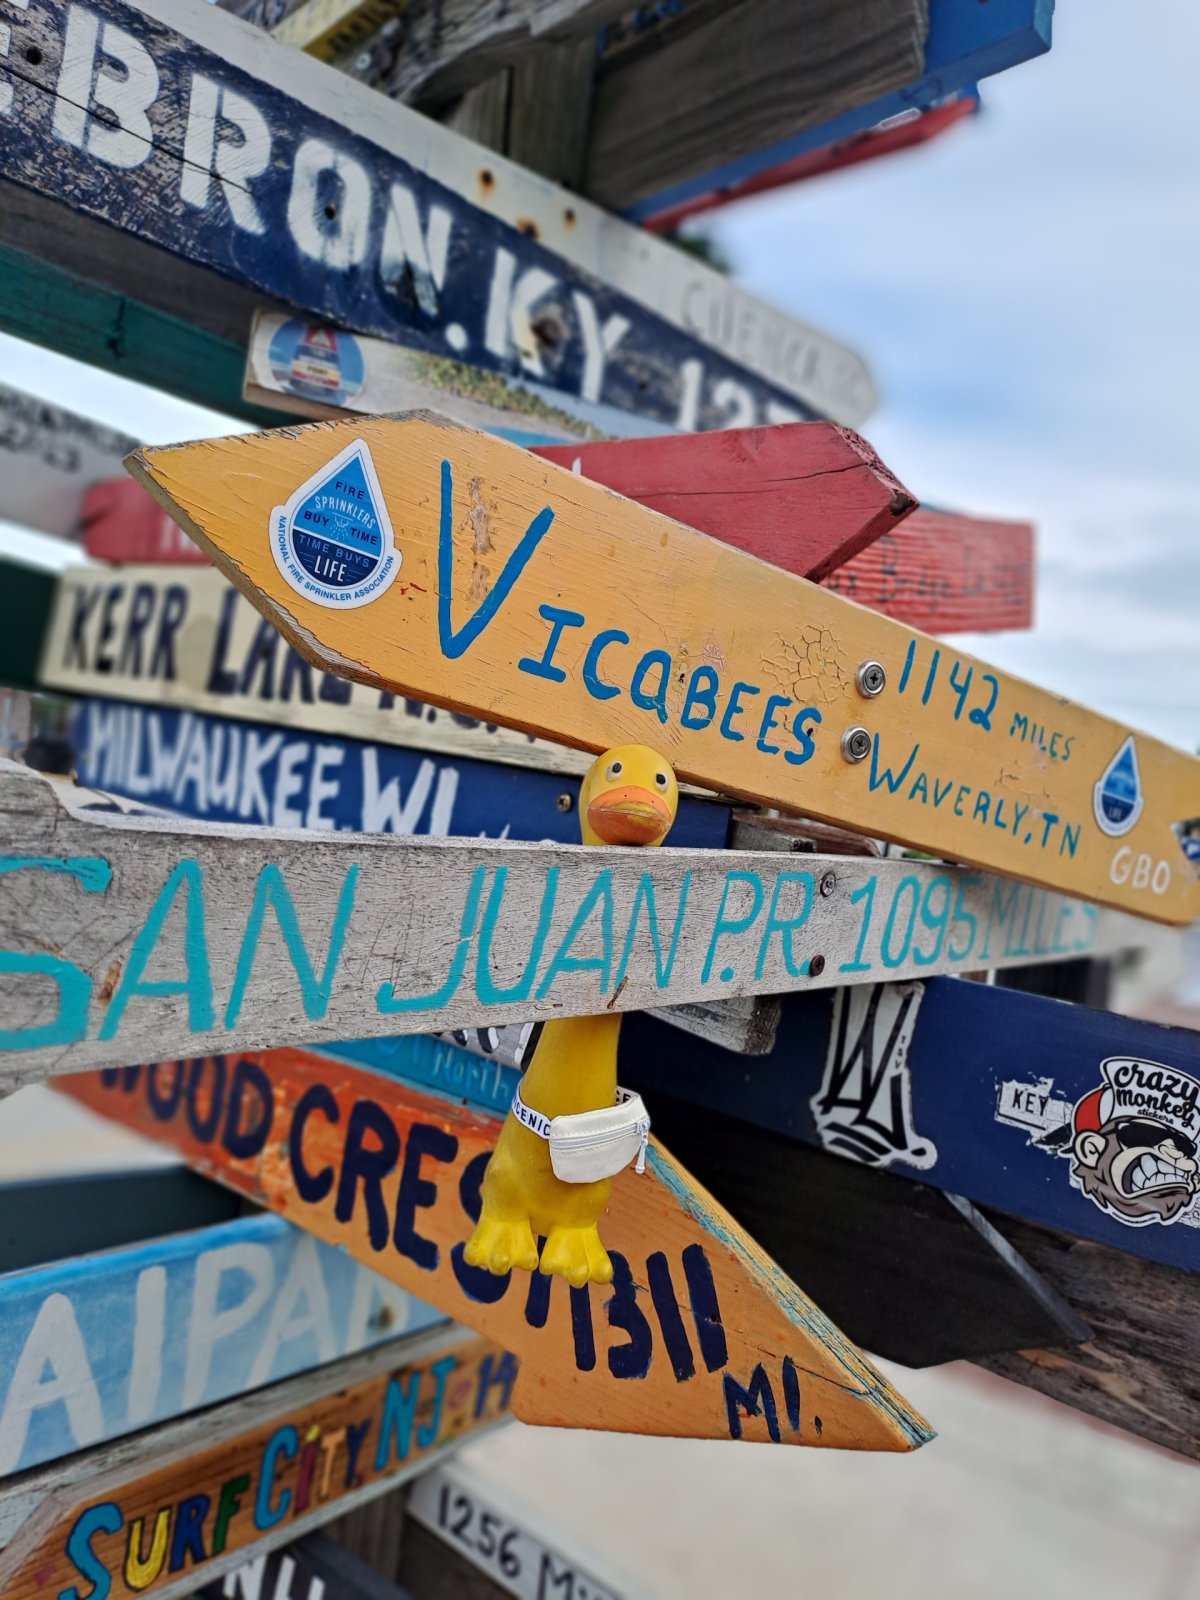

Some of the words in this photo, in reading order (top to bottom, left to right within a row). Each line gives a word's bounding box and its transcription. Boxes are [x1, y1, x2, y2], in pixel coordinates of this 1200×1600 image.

[315, 495, 377, 529] SPRINKLERS
[335, 481, 365, 500] FIRE
[299, 533, 330, 554] TIME
[335, 548, 370, 568] BUYS
[304, 510, 330, 526] BUY
[350, 527, 378, 546] TIME
[277, 515, 289, 564] NATIONAL
[287, 563, 304, 584] FIRE
[304, 582, 352, 601] SPRINKLER
[353, 555, 394, 600] ASSOCIATION
[314, 555, 348, 582] LIFE
[62, 583, 190, 681] KERR
[898, 639, 999, 732] 1142
[1009, 711, 1076, 762] MILES
[1109, 844, 1172, 895] GBO
[0, 857, 359, 1051] SAN
[376, 864, 692, 1015] JUAN
[839, 874, 983, 973] 1095
[977, 880, 1099, 960] MILES
[102, 1055, 274, 1159] OOD
[1012, 1088, 1049, 1117] KEY
[1115, 1088, 1195, 1131] monkey
[1137, 1108, 1174, 1125] stickers
[719, 1354, 823, 1443] MI.
[57, 1473, 250, 1600] SURF
[374, 1354, 457, 1472] NJ
[436, 1483, 521, 1579] 1256
